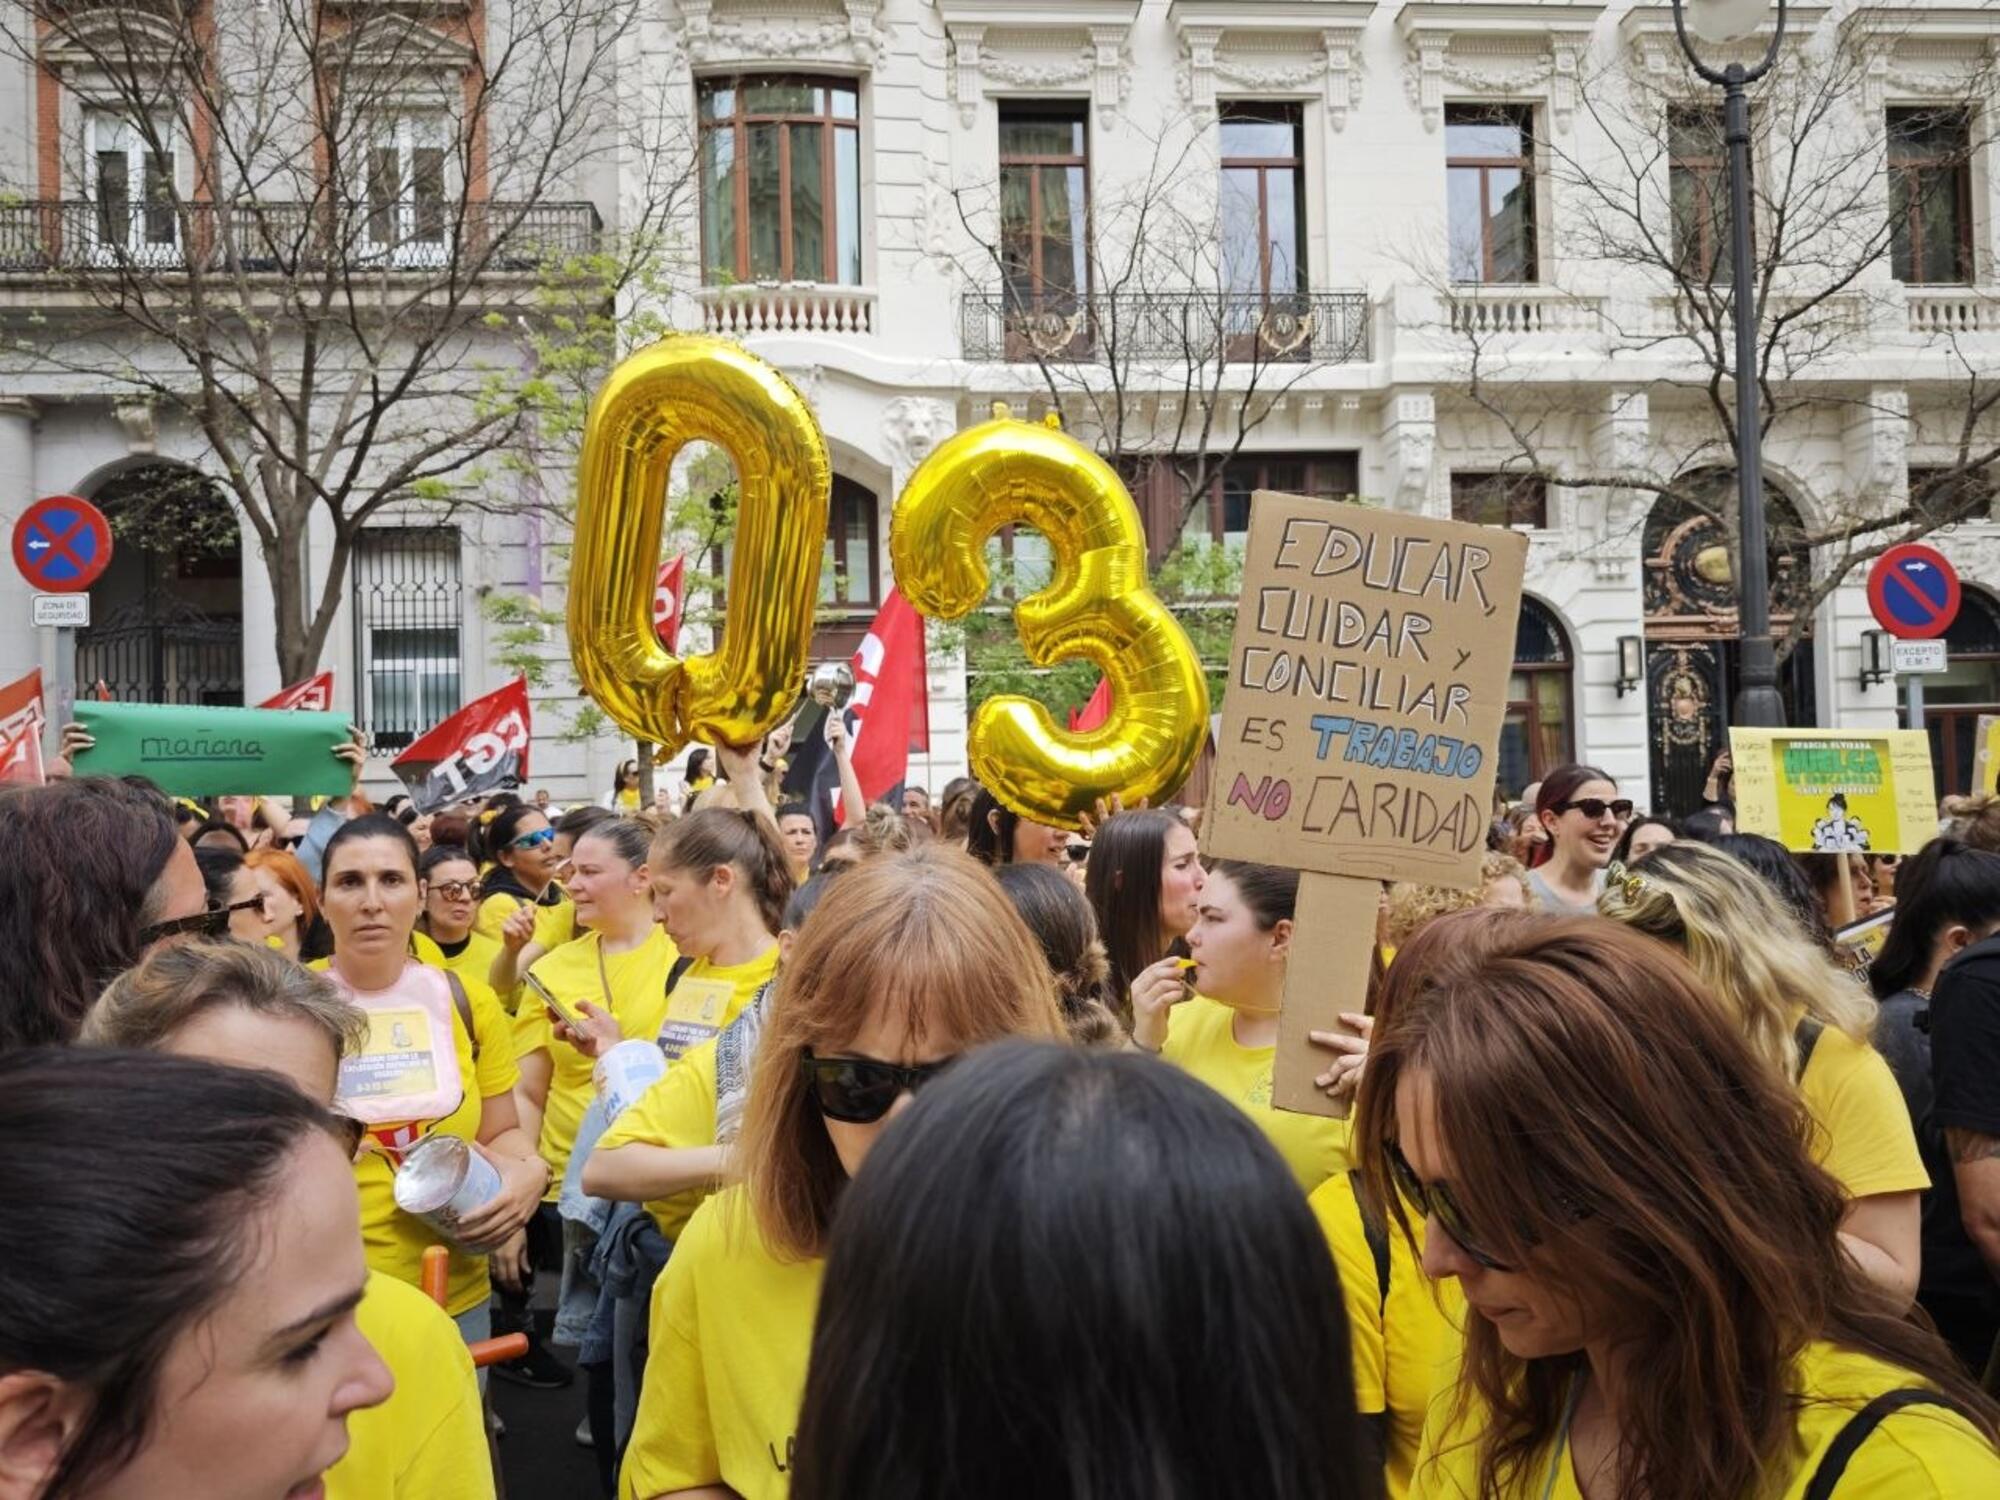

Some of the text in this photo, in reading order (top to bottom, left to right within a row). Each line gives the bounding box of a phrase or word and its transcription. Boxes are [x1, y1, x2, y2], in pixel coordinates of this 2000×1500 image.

[1275, 518, 1496, 617] EDUCAR,
[890, 412, 1209, 829] 3
[1258, 587, 1432, 663] CUIDAR
[1240, 647, 1471, 726] CONCILIAR
[140, 729, 265, 756] mañana
[1240, 714, 1484, 779] ES TRABAJO
[1783, 750, 1881, 774] HUELGA
[1227, 772, 1482, 852] NO CARIDAD
